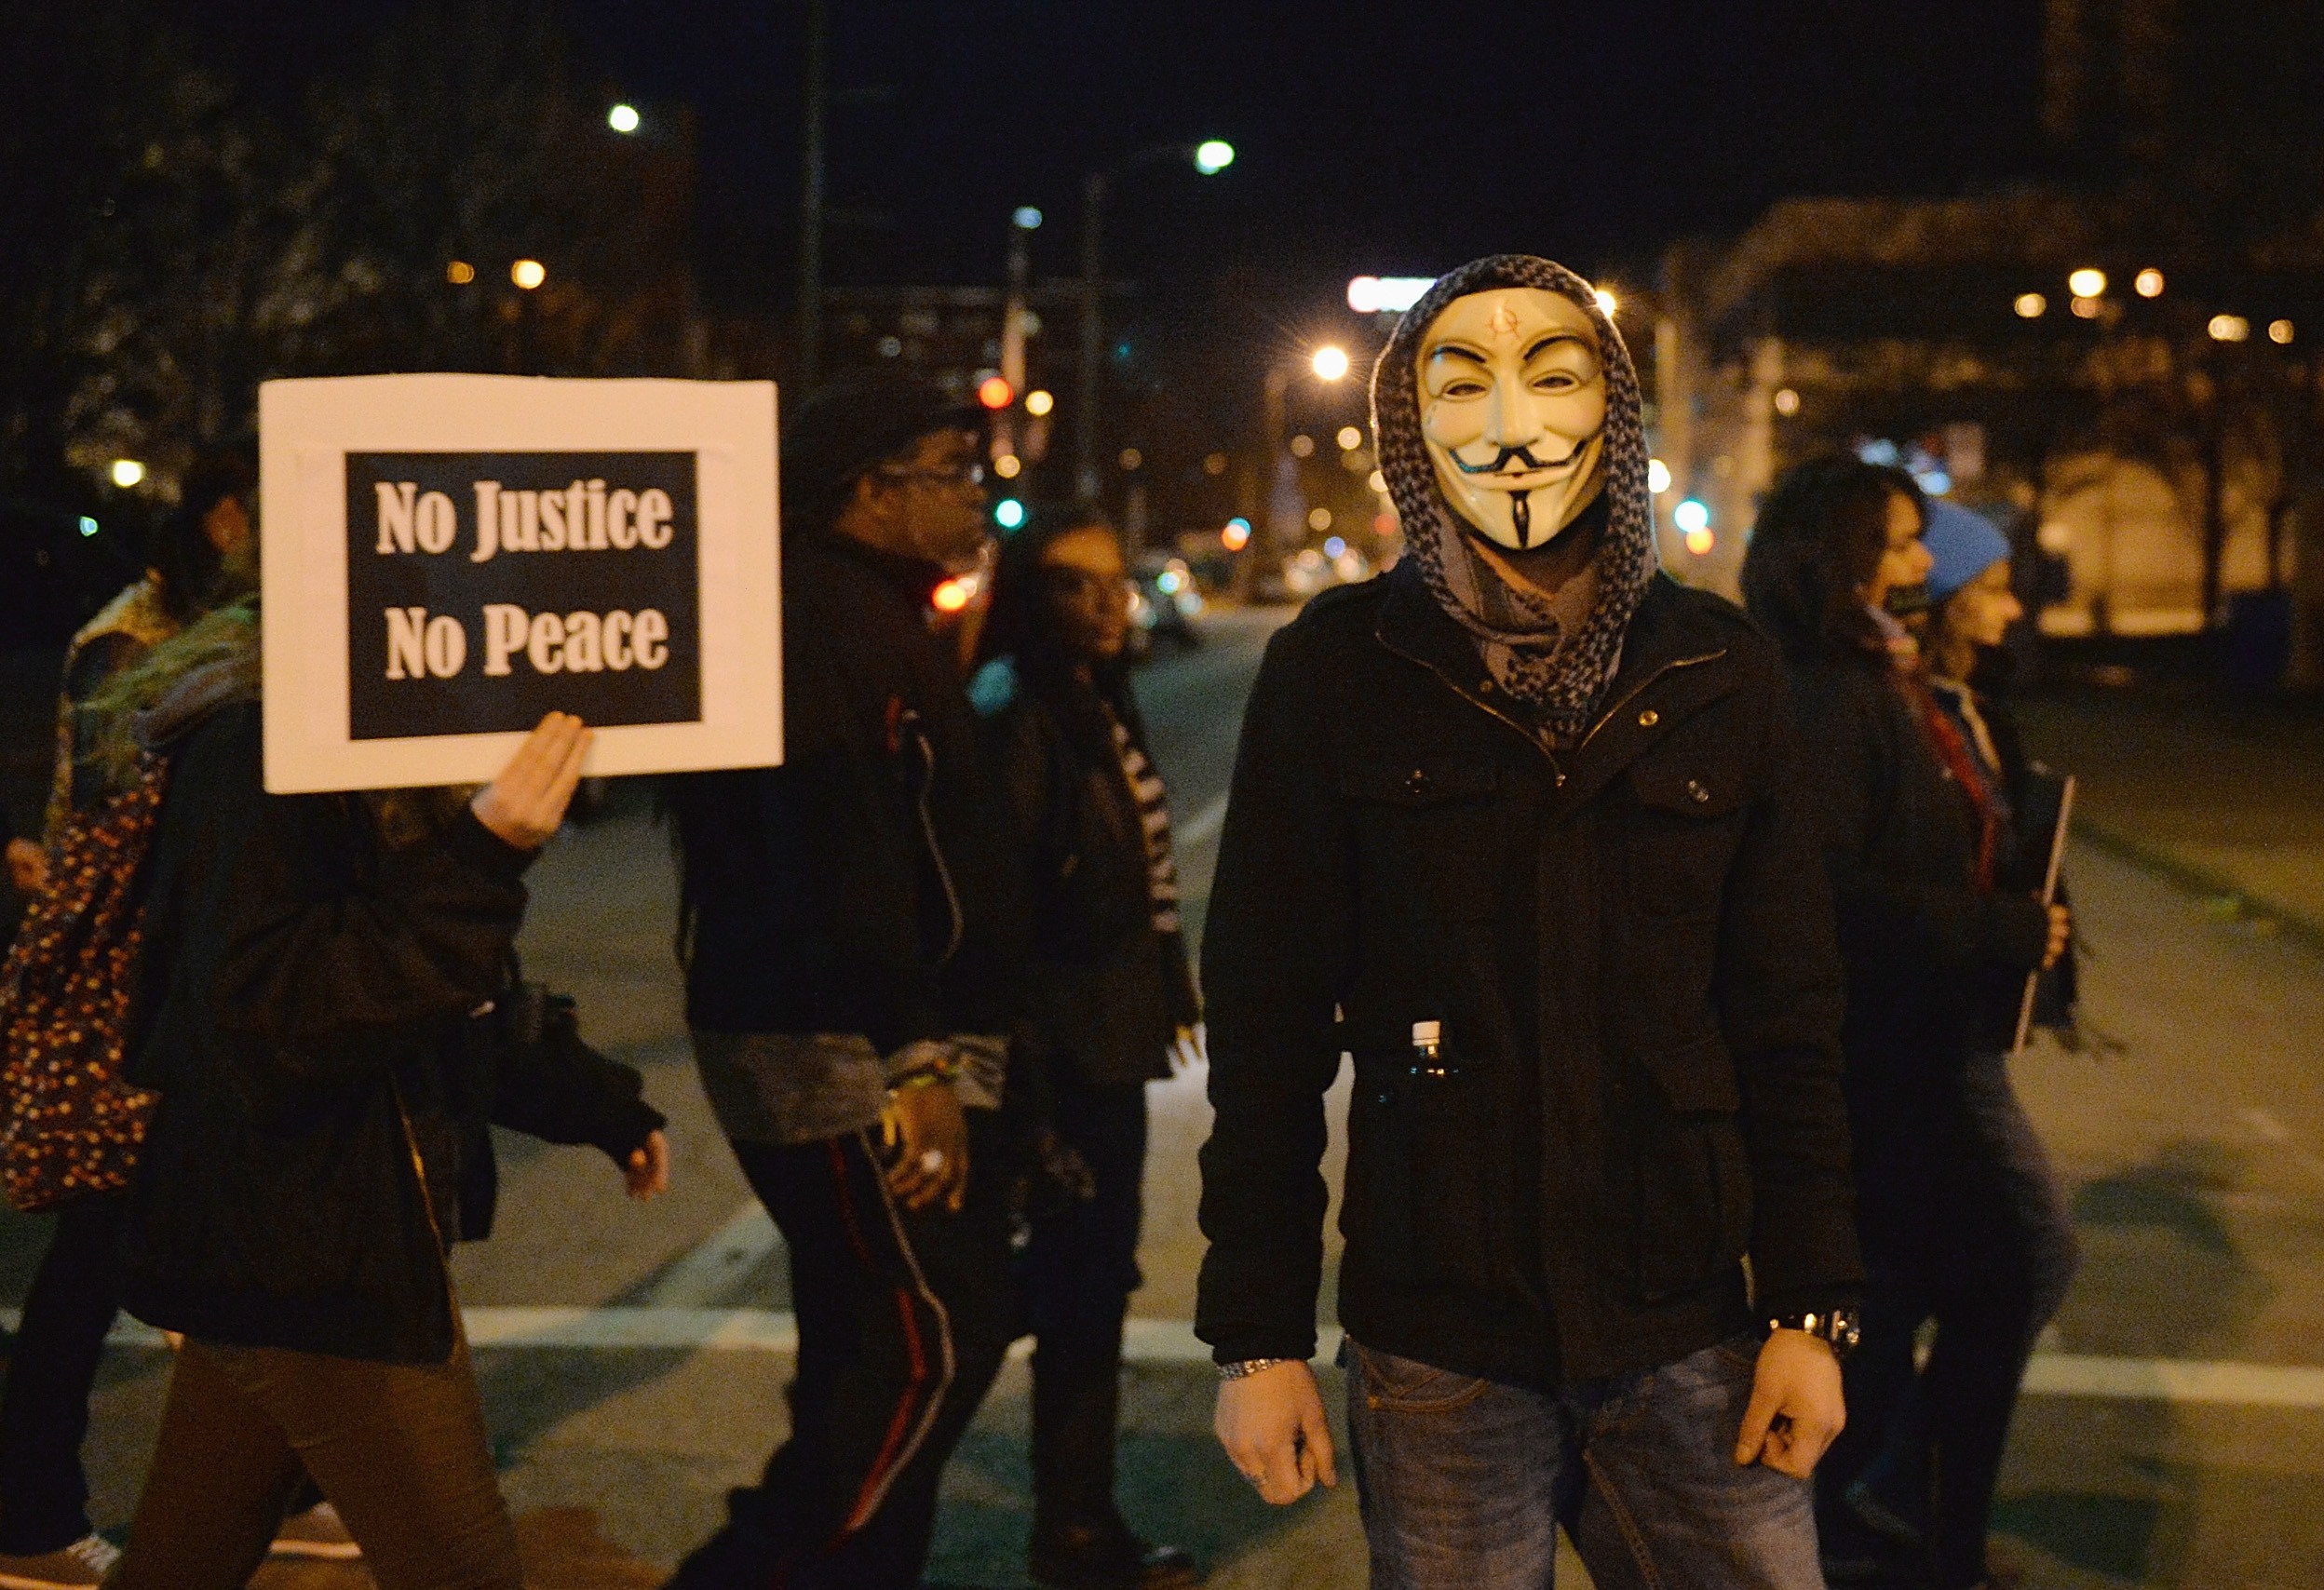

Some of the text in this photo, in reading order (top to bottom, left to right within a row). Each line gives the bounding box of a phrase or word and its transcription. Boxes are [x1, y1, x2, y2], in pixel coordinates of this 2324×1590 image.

[375, 479, 673, 562] No Justice
[385, 604, 669, 680] No Peace
